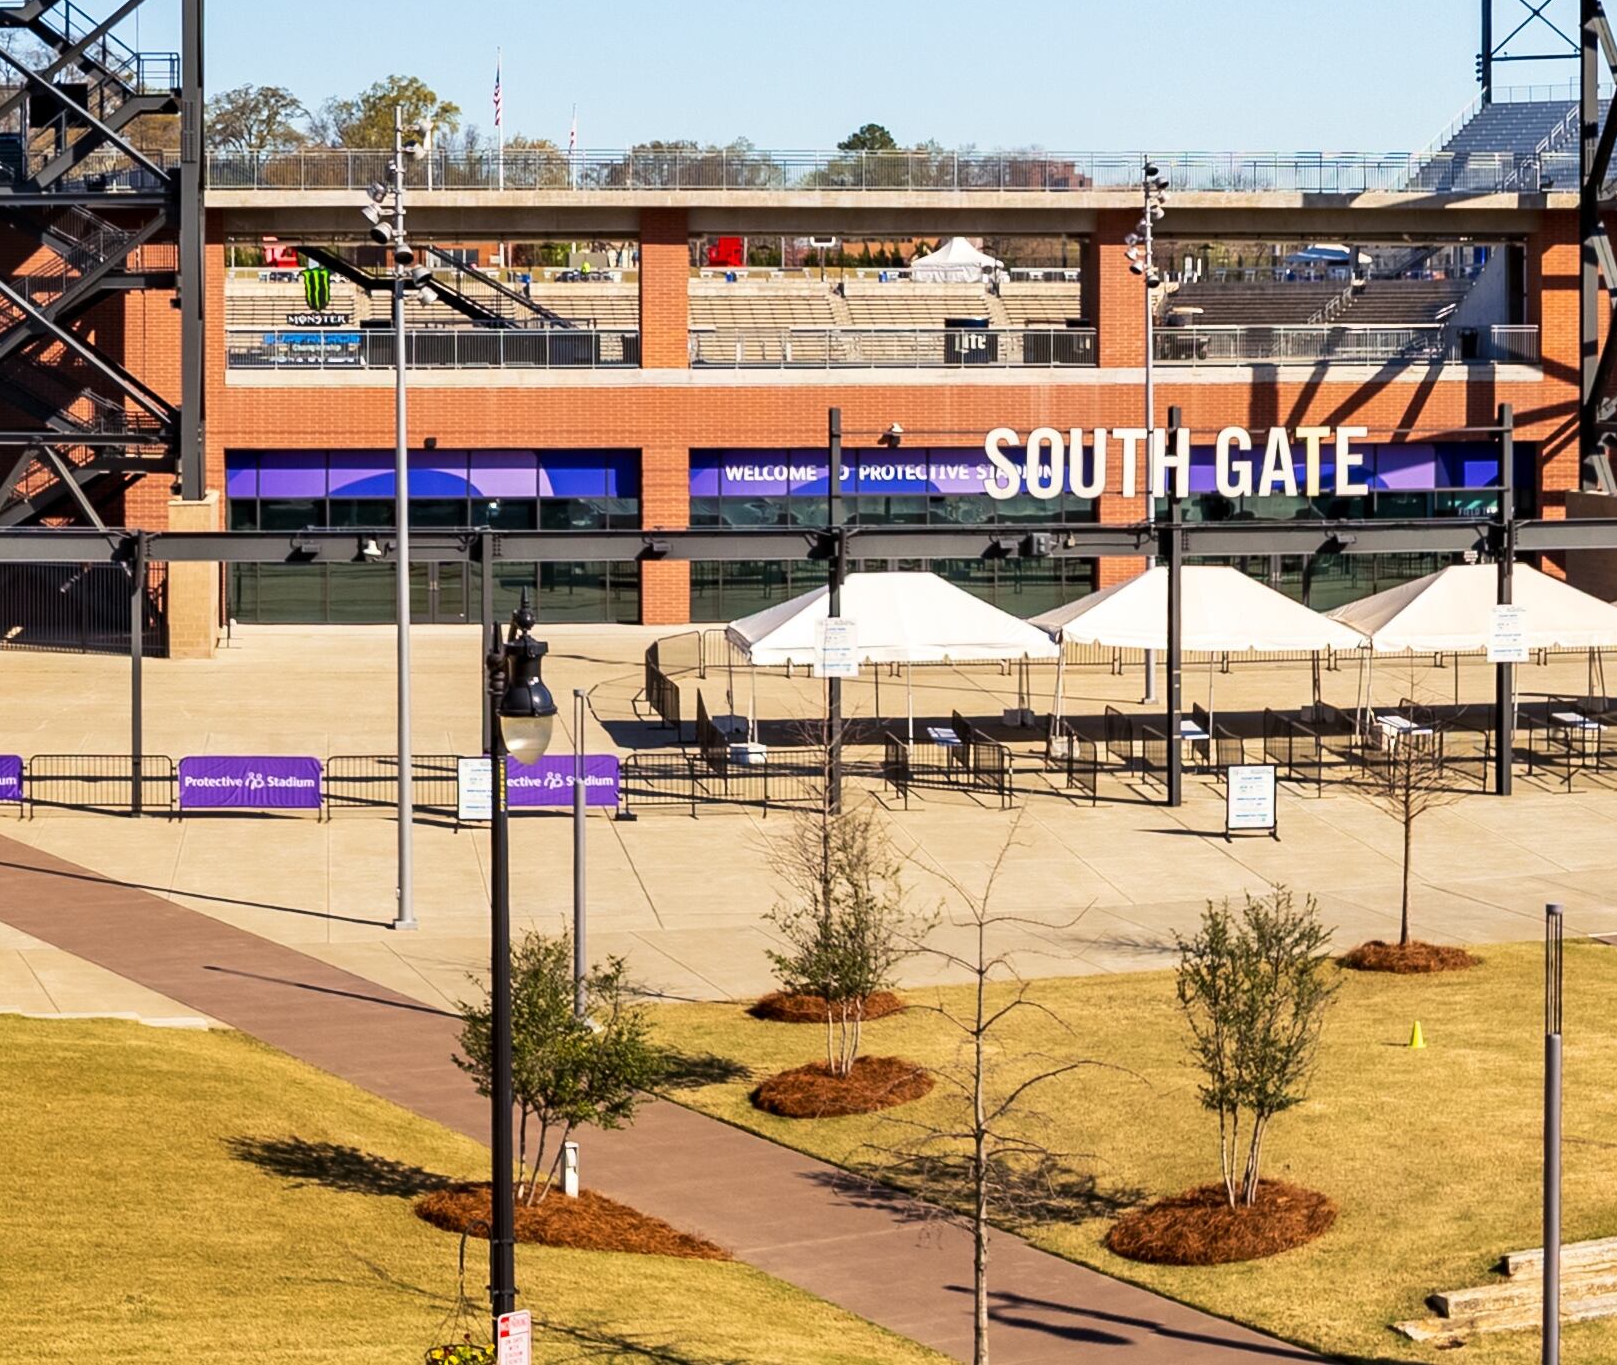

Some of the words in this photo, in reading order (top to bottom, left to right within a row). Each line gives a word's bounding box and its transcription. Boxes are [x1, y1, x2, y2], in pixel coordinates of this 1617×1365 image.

[287, 314, 346, 325] MONSTER
[983, 426, 1191, 500] SOUTH
[1215, 425, 1370, 499] GATE
[725, 464, 818, 482] WELCOME
[858, 463, 970, 481] PROTECTIVE
[184, 775, 243, 789] Protective
[266, 776, 315, 789] Stadium
